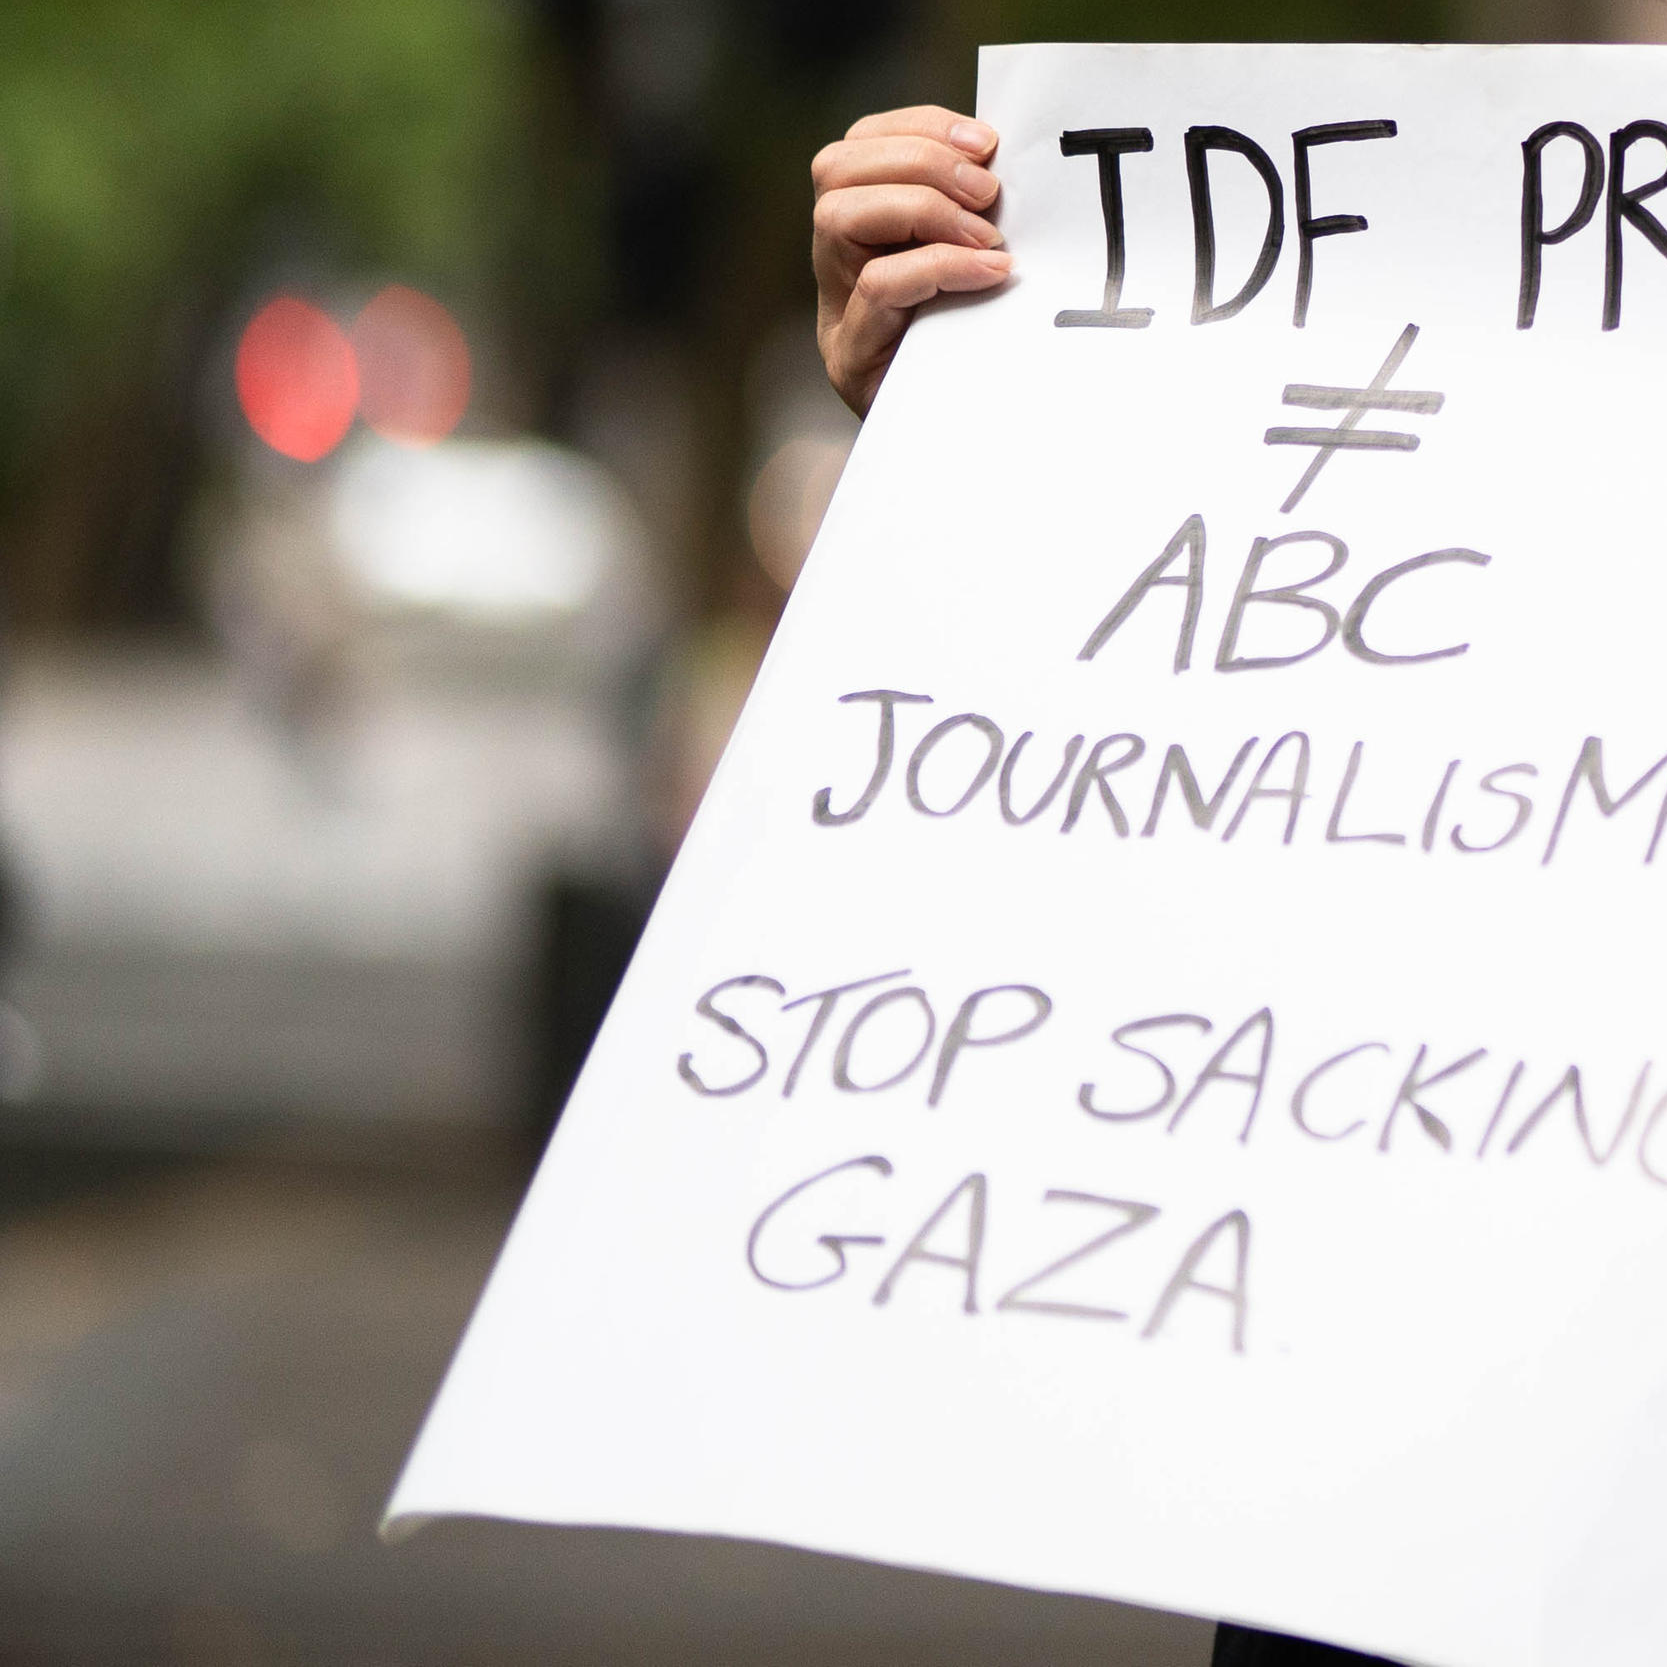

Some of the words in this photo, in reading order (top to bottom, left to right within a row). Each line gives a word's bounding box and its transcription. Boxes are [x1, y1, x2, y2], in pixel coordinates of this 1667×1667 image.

[1053, 117, 1398, 329] IDF
[1076, 513, 1493, 675] ABC
[676, 968, 1054, 1110] STOP
[745, 1154, 1252, 1356] GAZA
